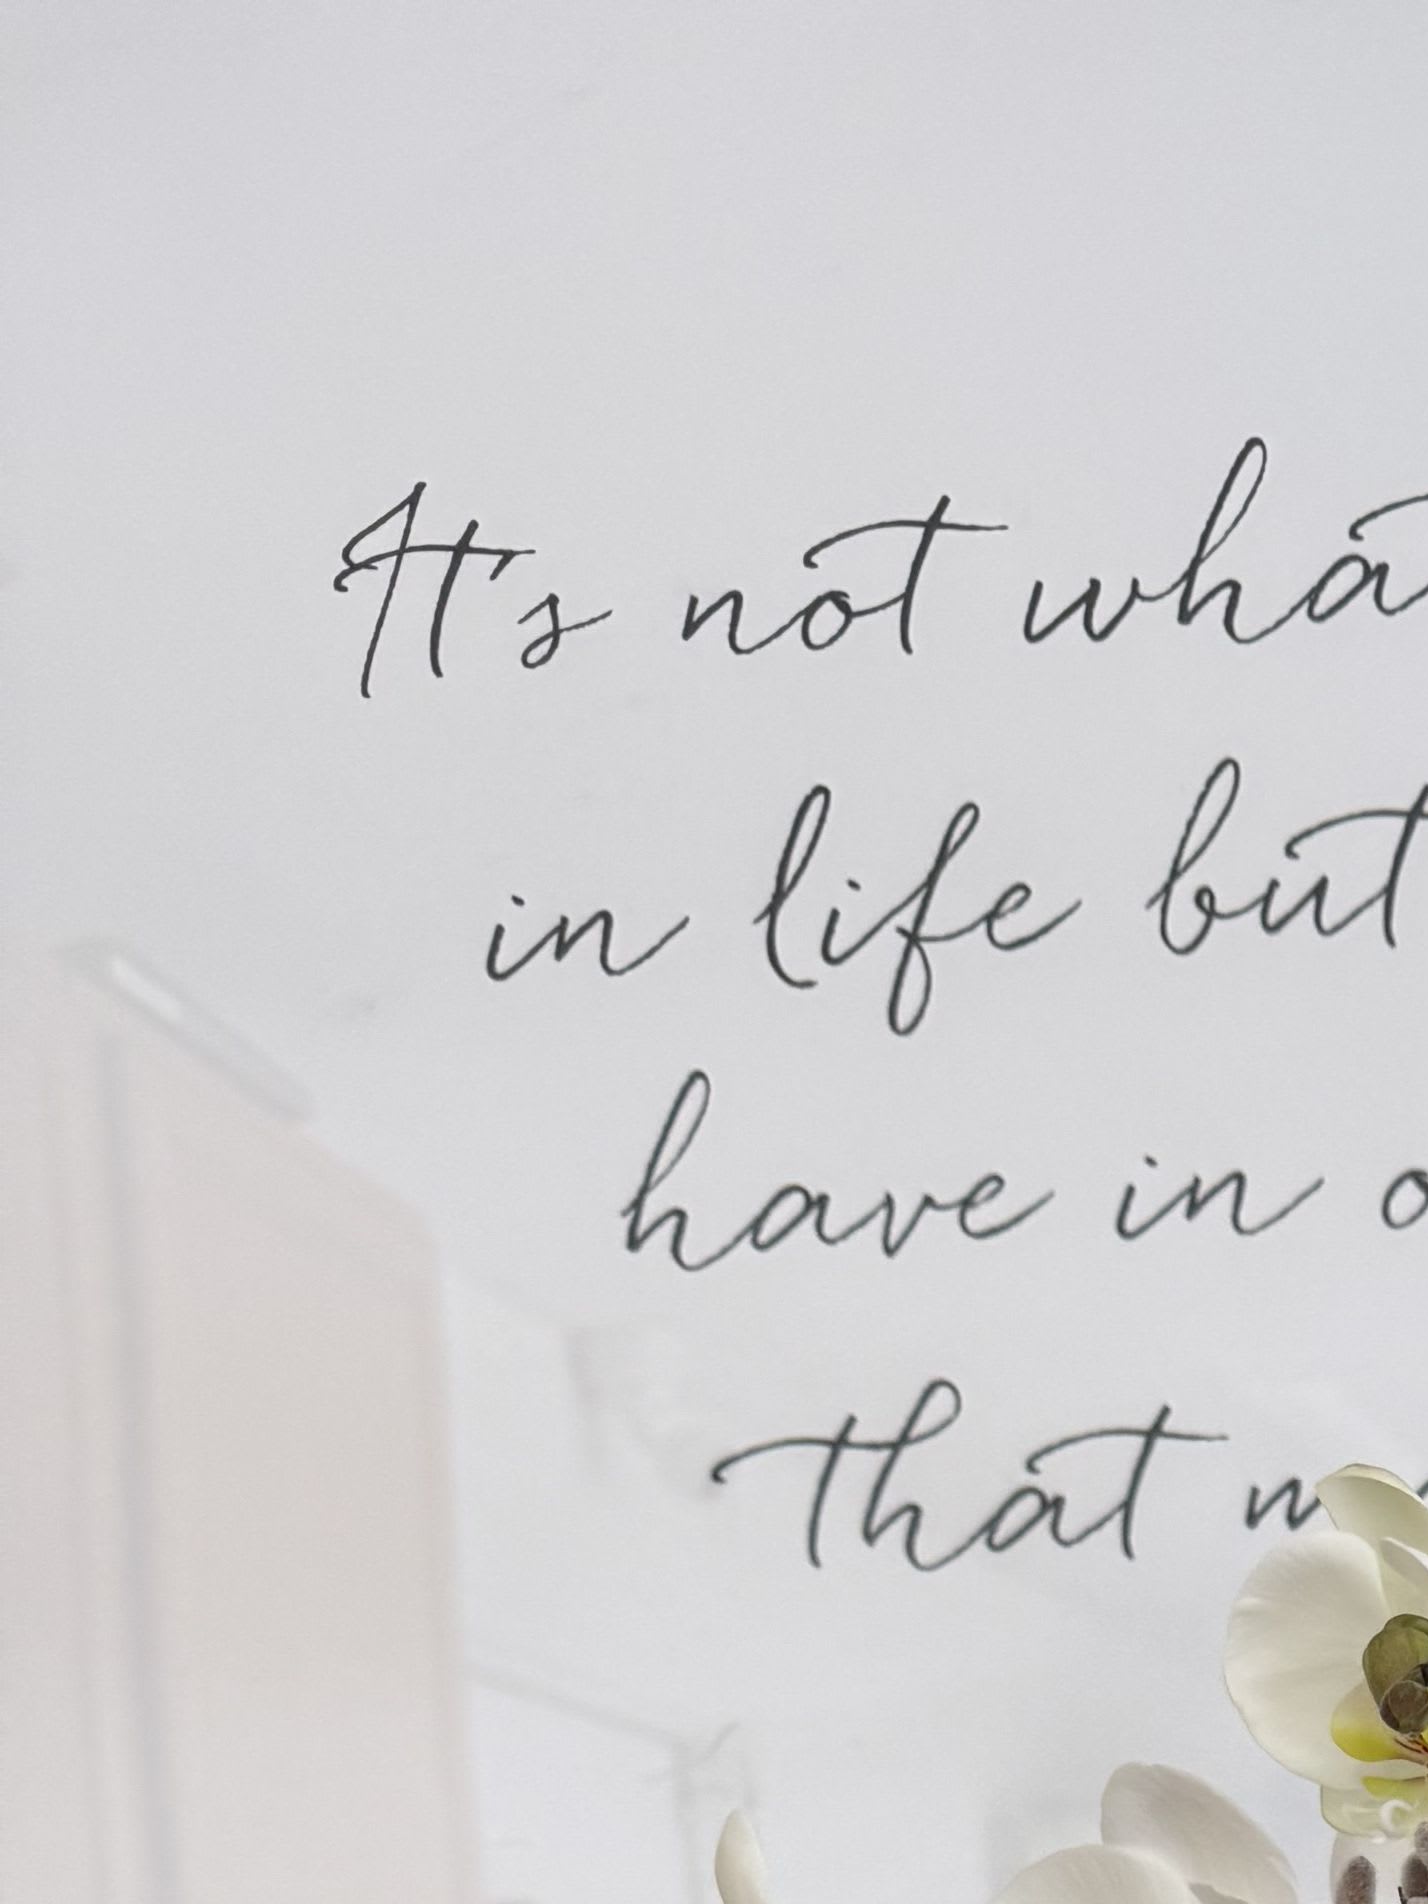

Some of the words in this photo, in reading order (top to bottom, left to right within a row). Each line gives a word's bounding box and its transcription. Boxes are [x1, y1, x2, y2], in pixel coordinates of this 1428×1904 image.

[333, 481, 612, 699] It's
[681, 495, 1009, 655] not
[485, 895, 690, 983] in
[753, 784, 1082, 1039] life
[620, 1069, 1054, 1272] have
[1115, 1155, 1324, 1241] in
[709, 1378, 1229, 1572] that
